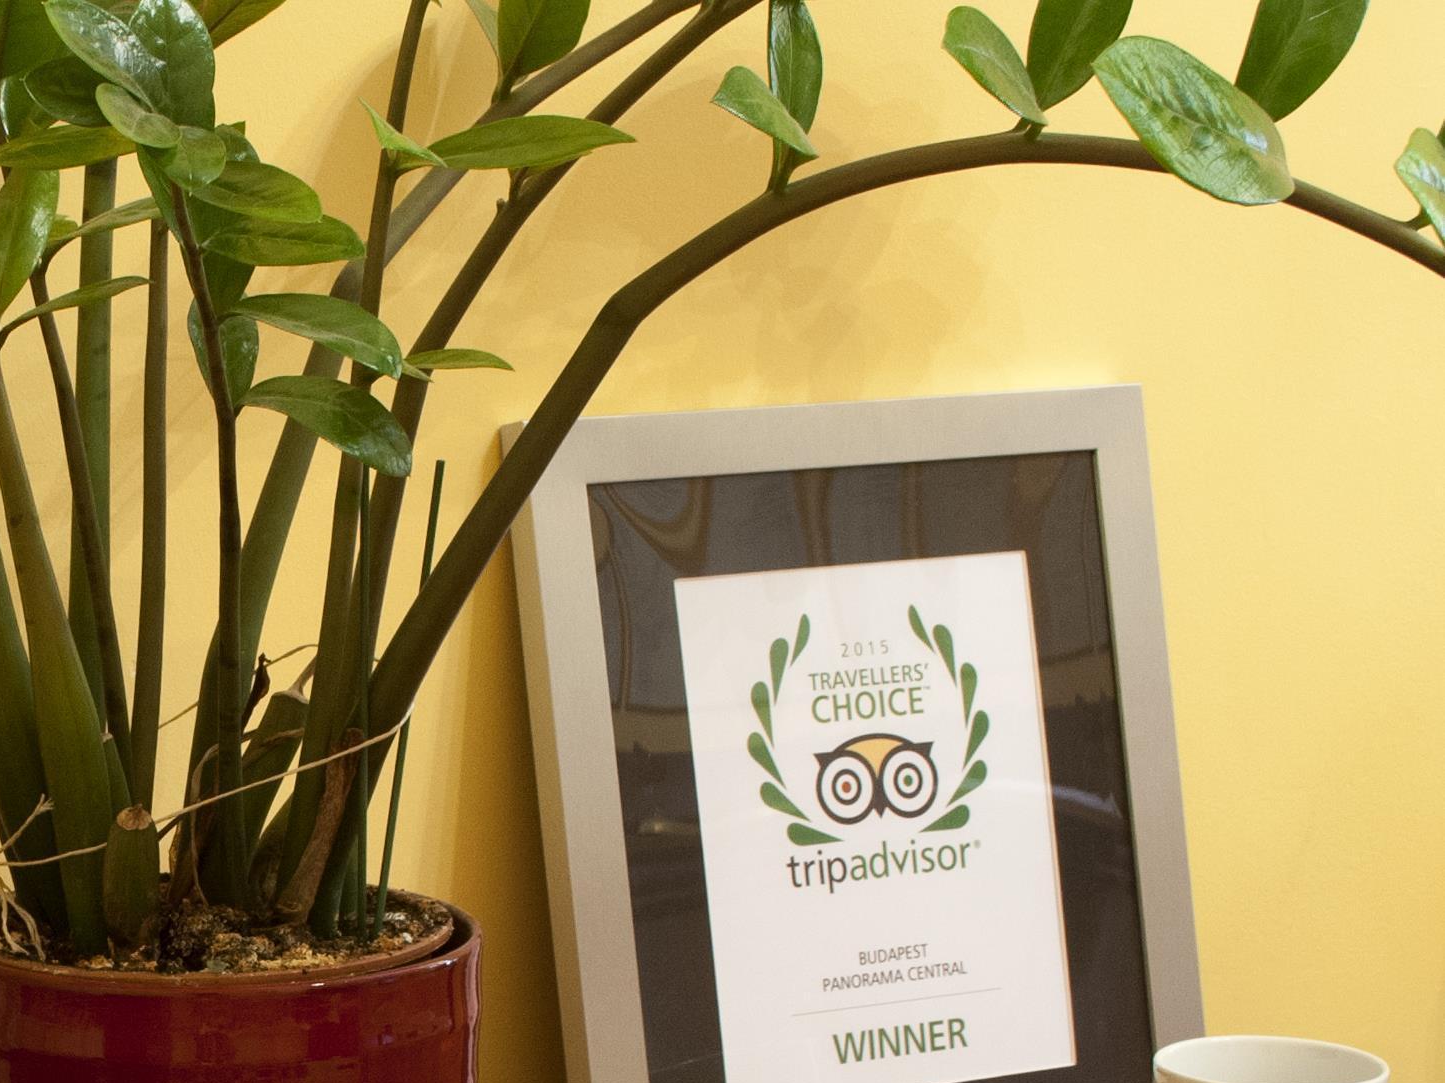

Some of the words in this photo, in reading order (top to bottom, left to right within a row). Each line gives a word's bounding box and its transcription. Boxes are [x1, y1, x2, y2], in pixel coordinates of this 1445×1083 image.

[841, 639, 890, 658] 2015
[811, 686, 925, 724] CHOICE
[786, 839, 971, 894] tripadvisor
[858, 943, 928, 967] BUDAPEST
[822, 967, 904, 993] PANORAMA
[907, 960, 968, 982] CENTRAL
[832, 1017, 969, 1066] WINNER
